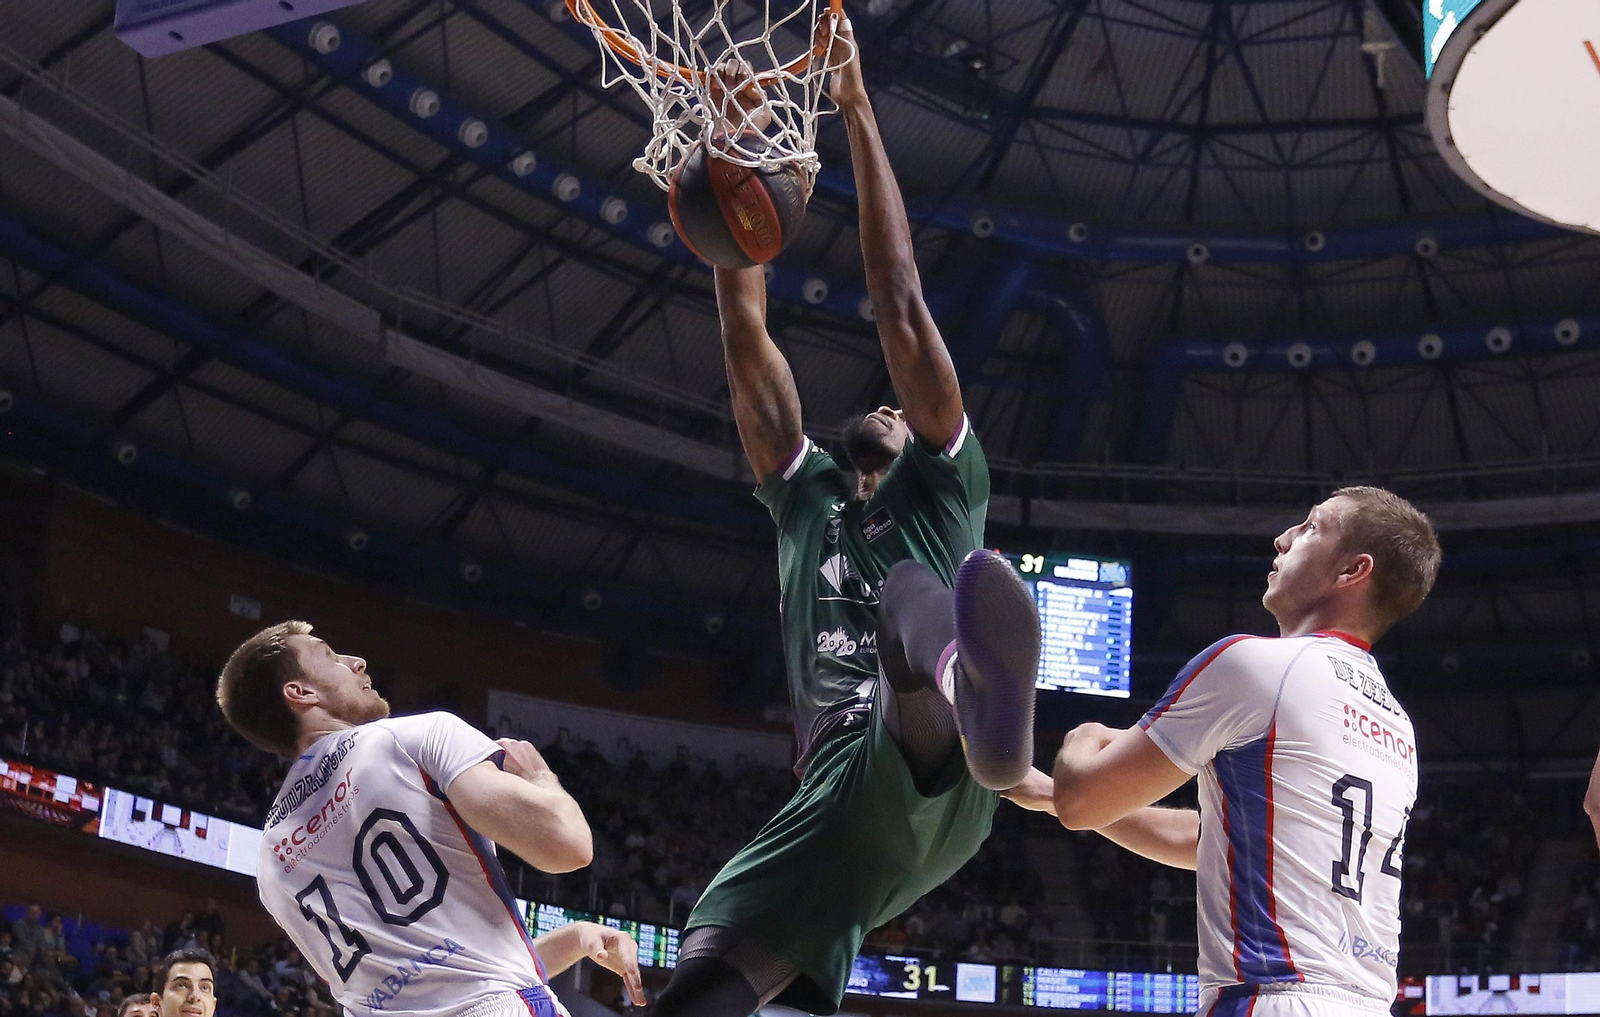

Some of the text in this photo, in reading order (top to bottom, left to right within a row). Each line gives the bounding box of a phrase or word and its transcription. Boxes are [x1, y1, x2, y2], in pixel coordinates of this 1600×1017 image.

[866, 519, 892, 540] endesa
[1019, 553, 1045, 574] 31
[1358, 714, 1414, 765] cenor
[291, 767, 353, 846] cenor
[295, 807, 450, 984] 10
[903, 964, 938, 993] 31
